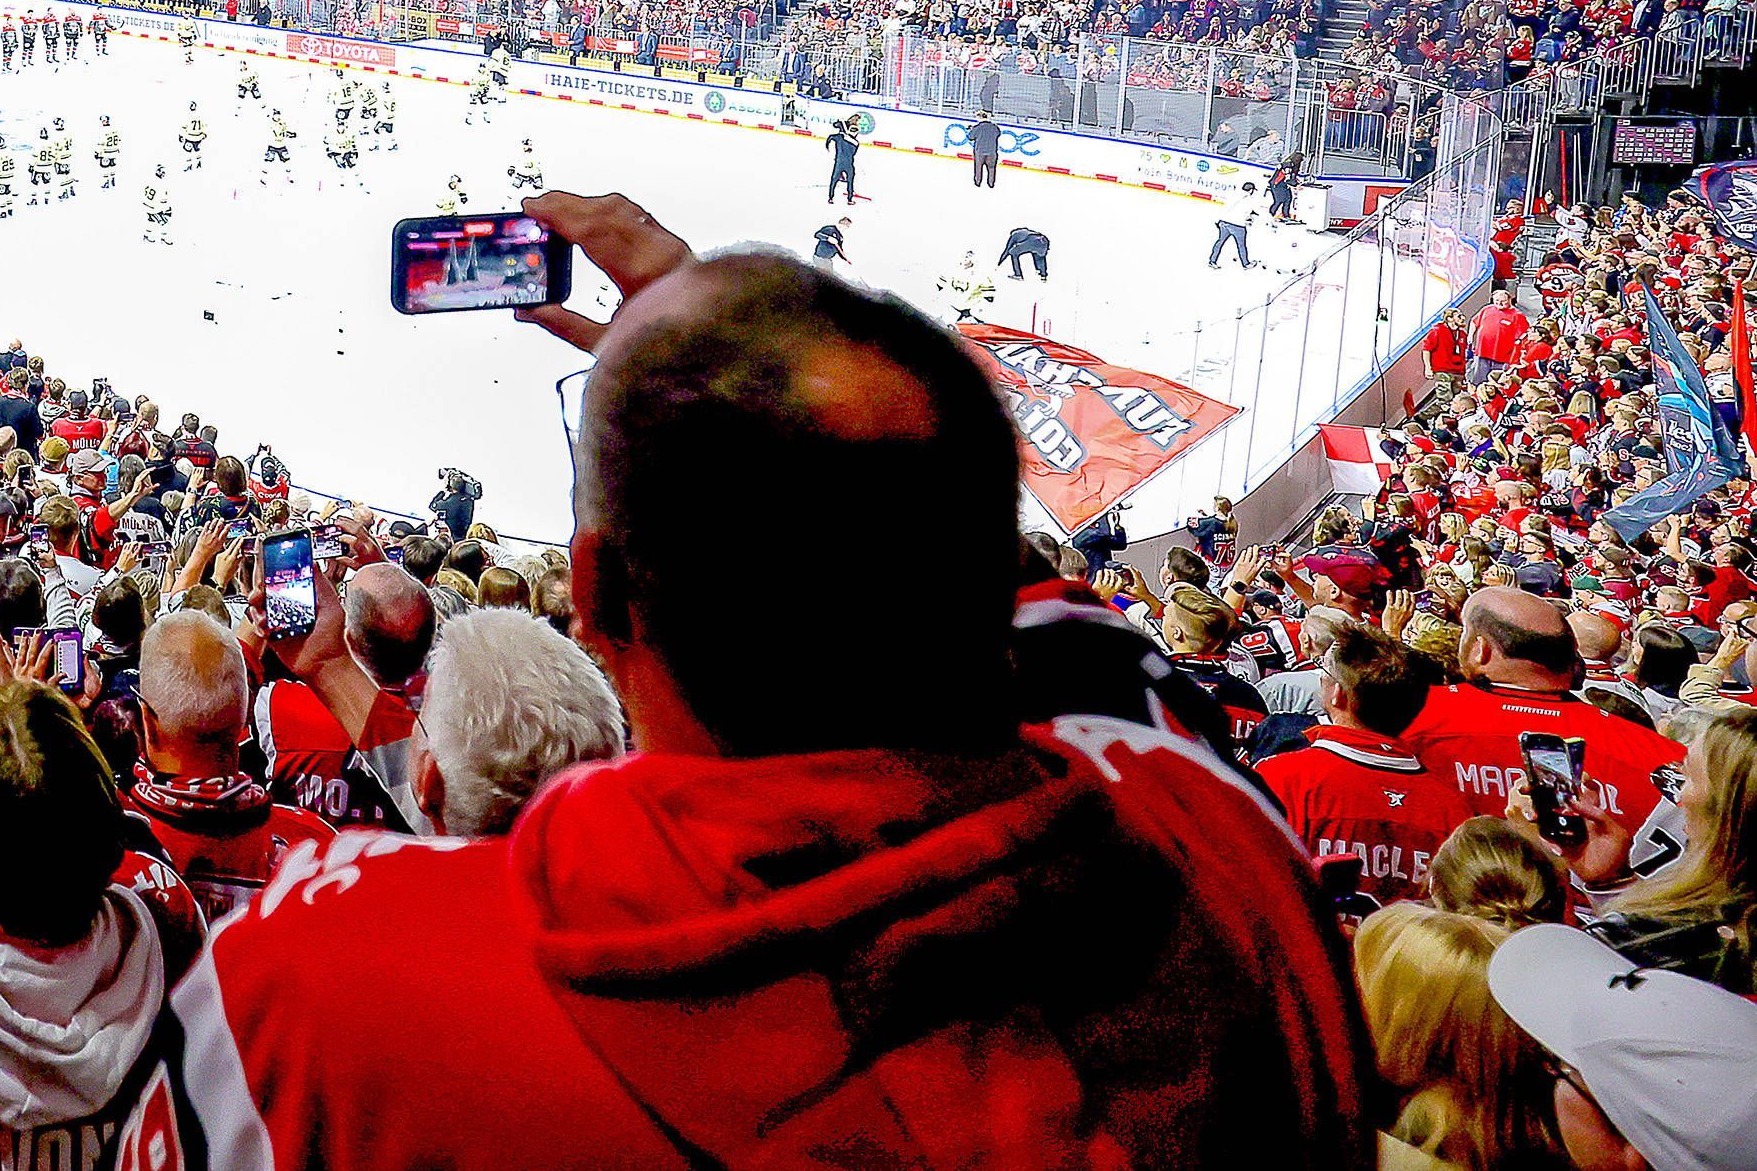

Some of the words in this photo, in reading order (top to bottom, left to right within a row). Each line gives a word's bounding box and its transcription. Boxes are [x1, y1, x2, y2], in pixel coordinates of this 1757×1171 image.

[326, 43, 380, 62] TOYOTA
[551, 73, 694, 106] HAIE-TICKETS.DE
[1318, 838, 1430, 883] MACLE
